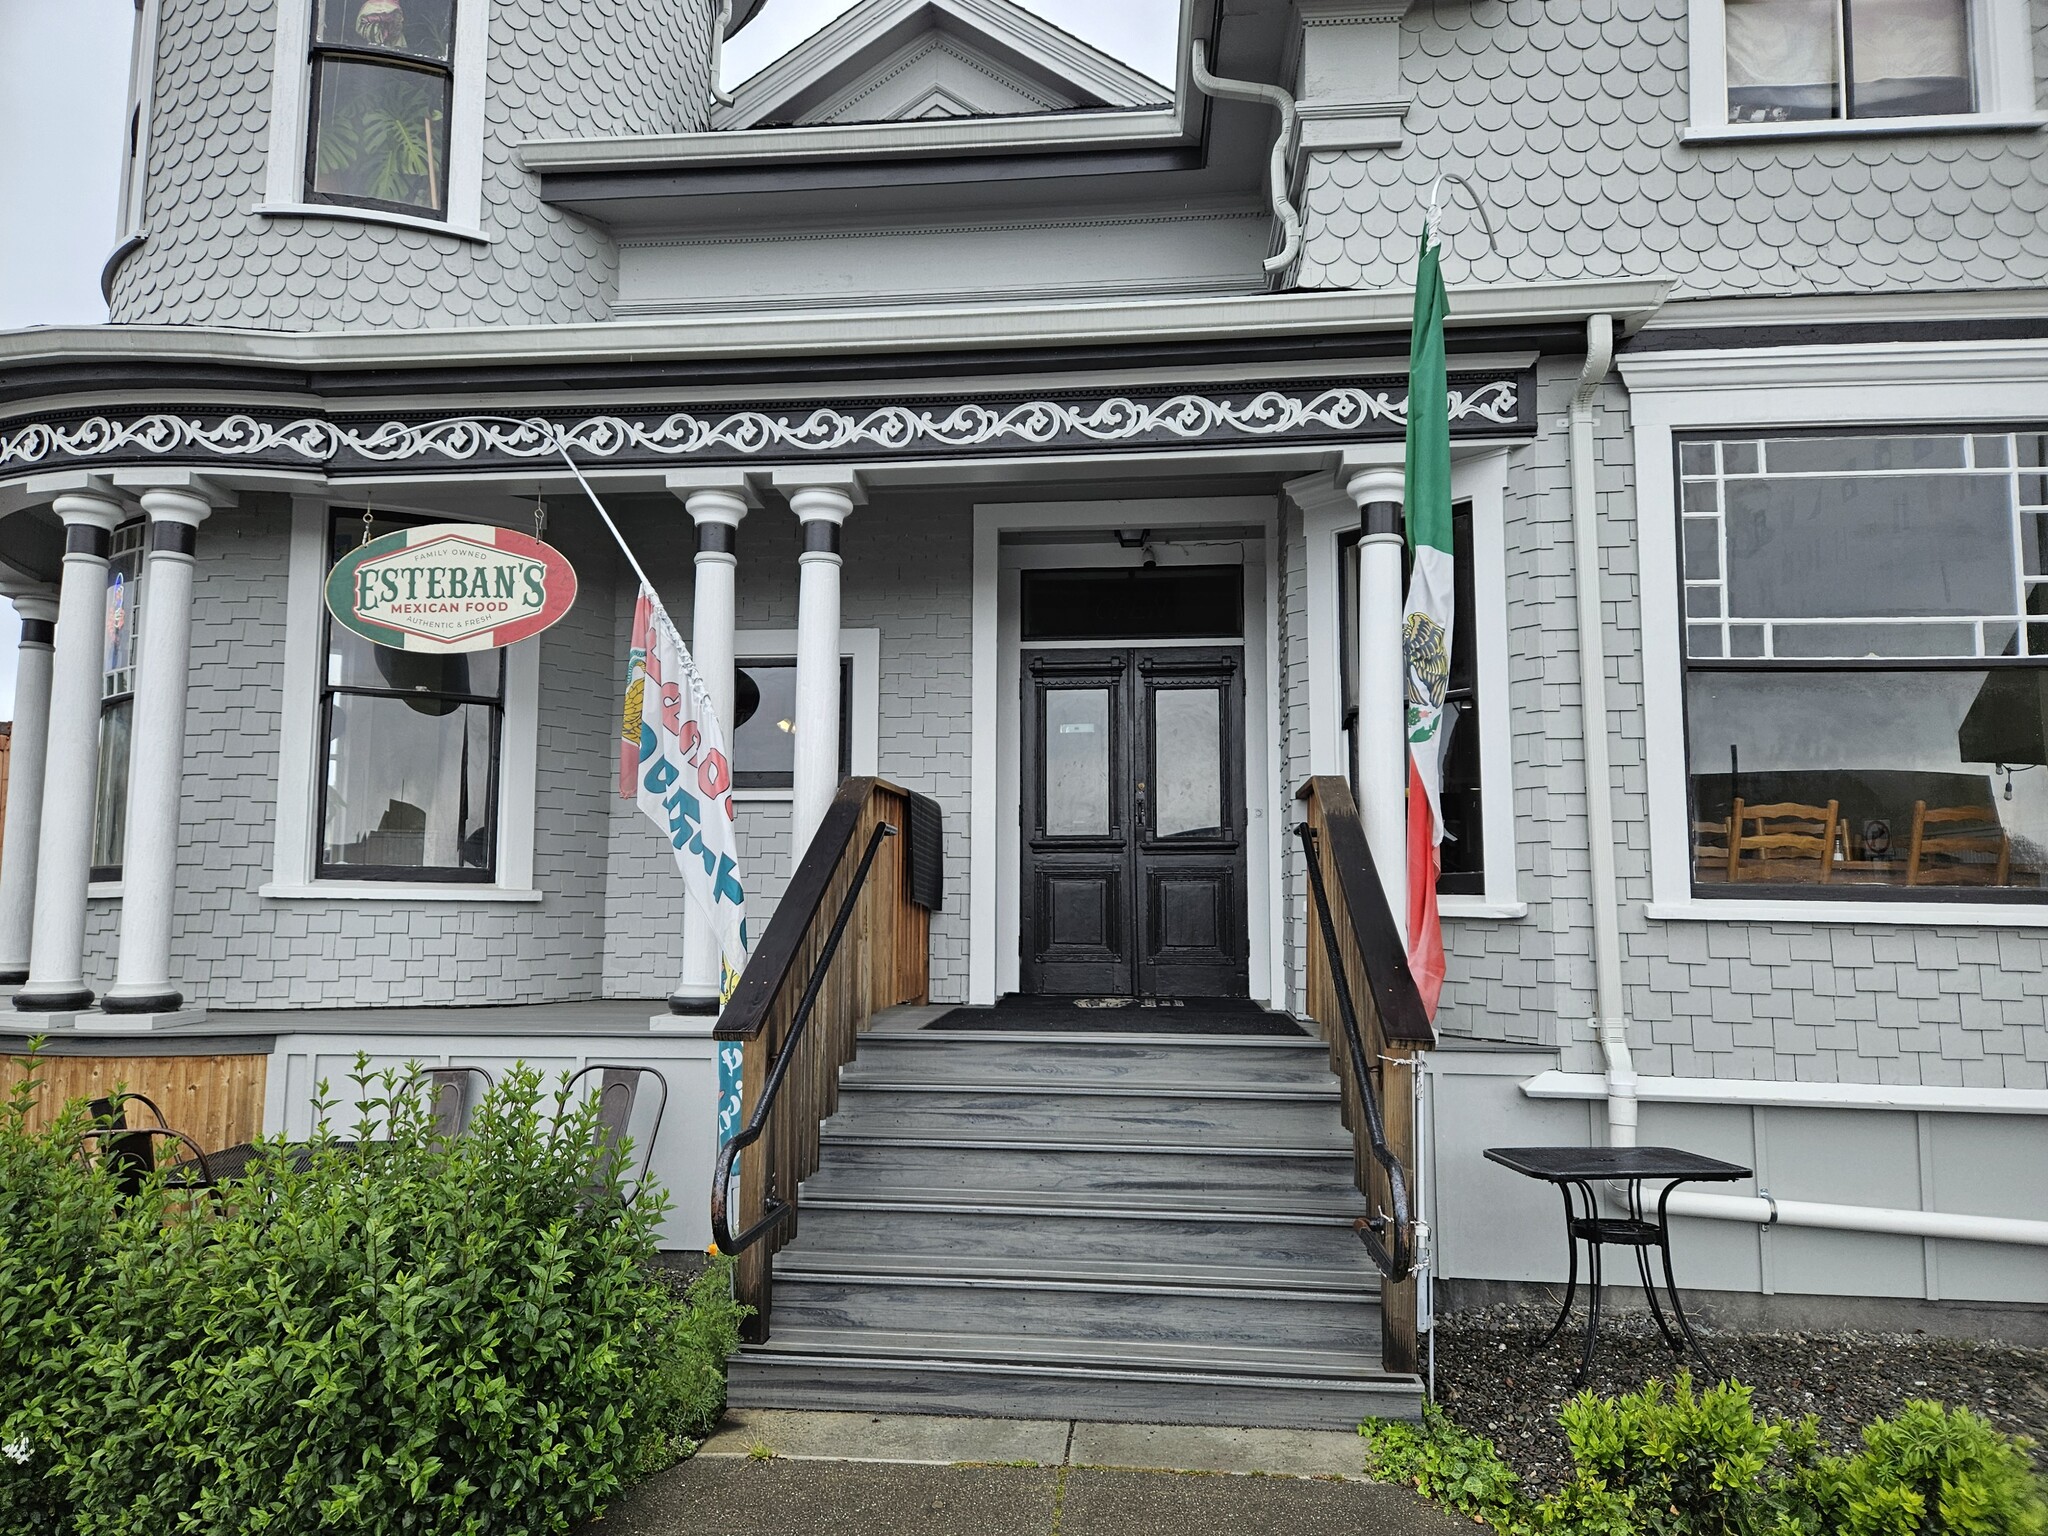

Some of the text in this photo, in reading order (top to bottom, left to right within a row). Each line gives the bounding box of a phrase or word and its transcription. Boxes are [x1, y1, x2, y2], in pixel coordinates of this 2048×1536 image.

[414, 549, 487, 562] FAMILY OWNED
[356, 562, 546, 611] ESTEBAN'S
[391, 602, 508, 614] MEXICAN FOOD
[406, 615, 454, 629] AUTHENTIC
[464, 614, 492, 627] FRESH
